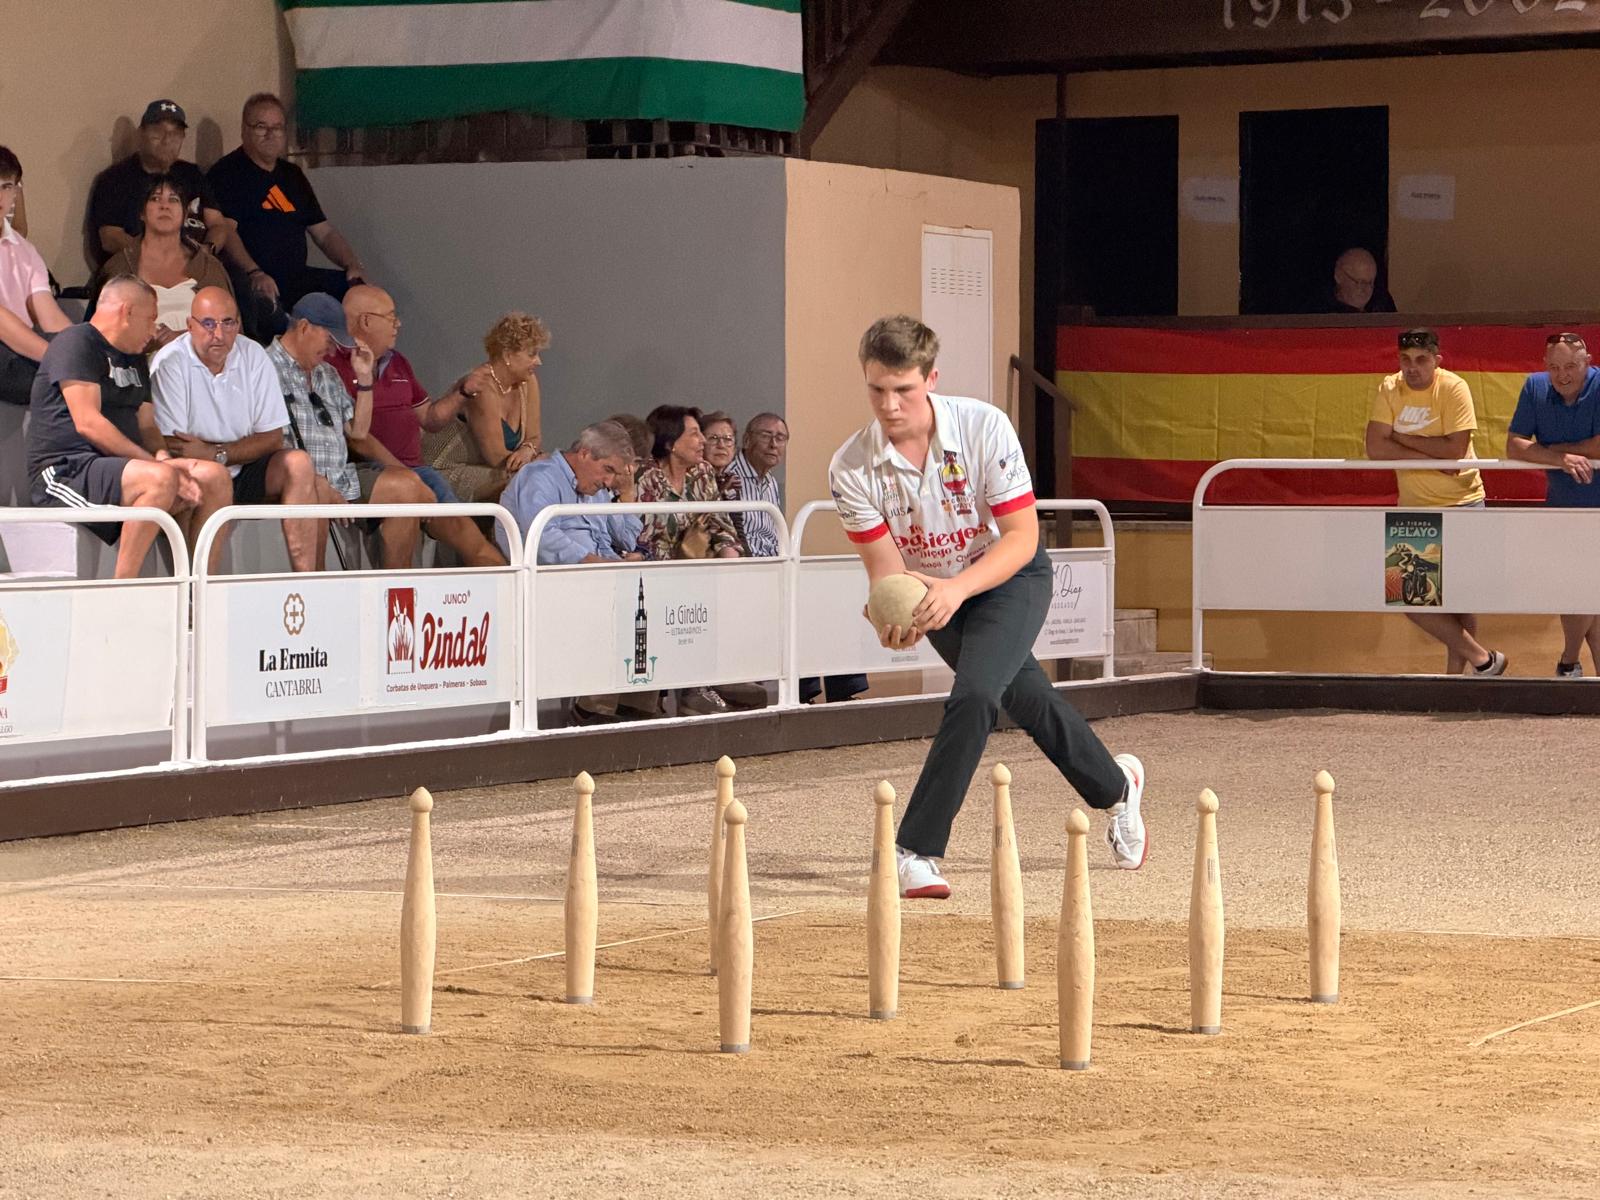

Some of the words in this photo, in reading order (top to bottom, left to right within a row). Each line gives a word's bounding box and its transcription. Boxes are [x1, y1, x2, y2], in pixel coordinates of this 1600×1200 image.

[1390, 526, 1438, 538] PELAYO
[665, 605, 675, 625] La
[677, 603, 707, 624] Giralda
[419, 611, 490, 671] Pindal
[259, 649, 277, 672] La
[280, 646, 328, 671] Ermita
[265, 678, 322, 698] CANTABRIA
[386, 684, 409, 693] Corbatas
[410, 682, 417, 691] de
[443, 679, 466, 689] Palmeras
